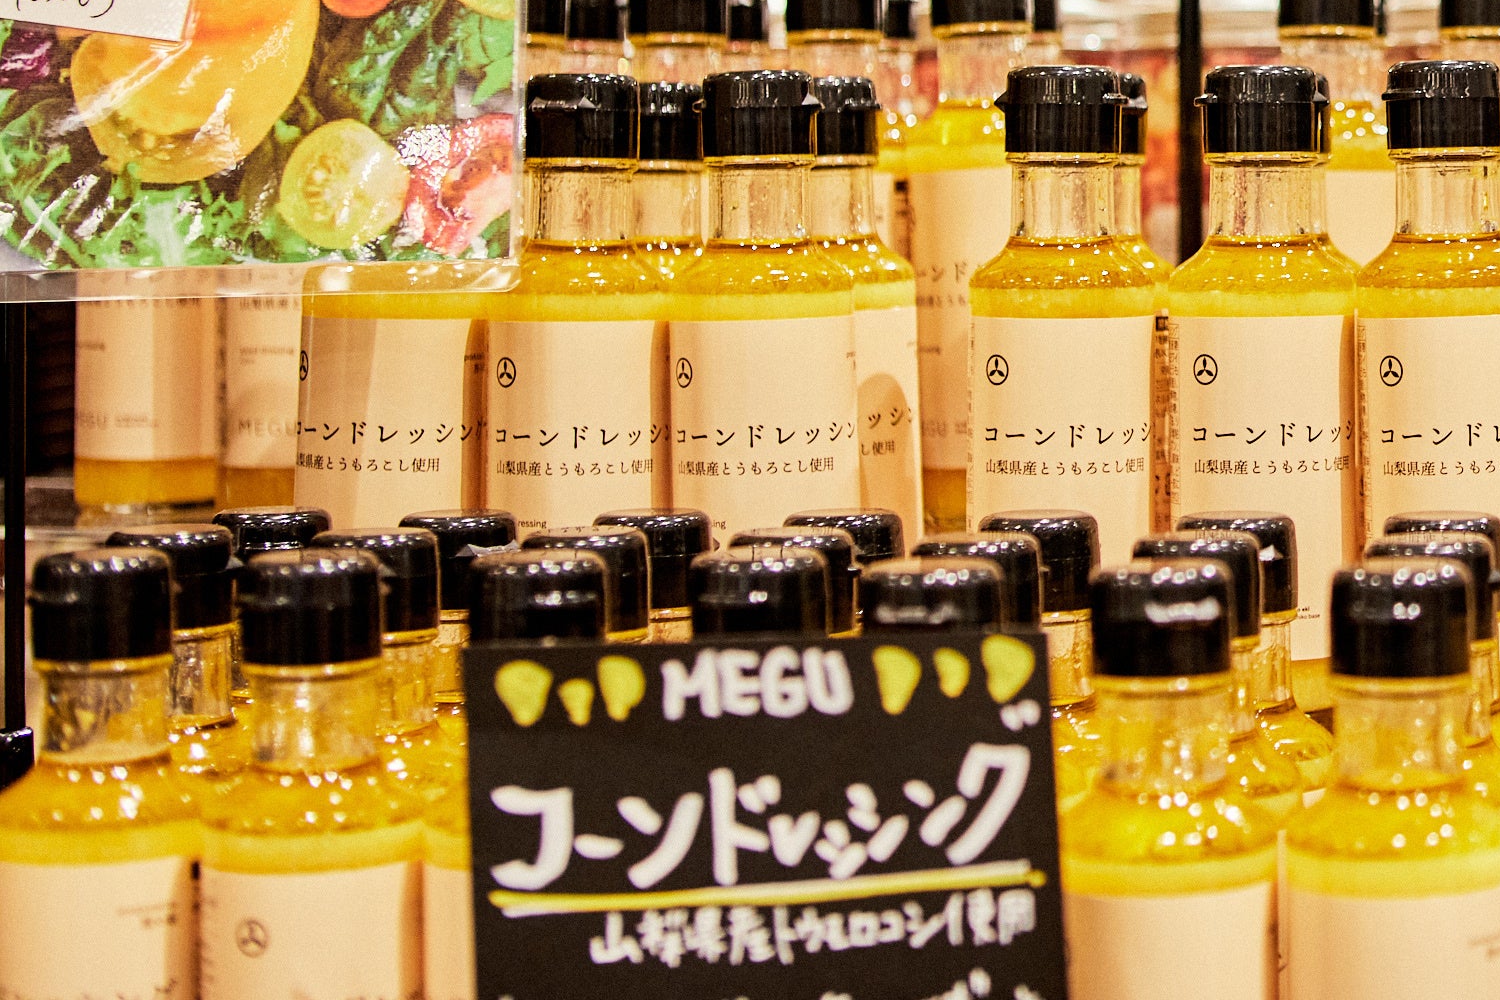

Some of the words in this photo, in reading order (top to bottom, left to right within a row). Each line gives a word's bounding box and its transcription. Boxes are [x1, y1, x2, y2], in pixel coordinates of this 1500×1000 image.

[297, 452, 440, 472] 梨県産とうもろこし使用
[496, 458, 653, 477] 山梨県産とうもろこし使用
[678, 456, 834, 477] 山梨県産とうもろこし使用
[985, 457, 1144, 477] 山梨県産とうもろこし使用
[1194, 456, 1350, 475] 山梨県産とうもろこし使用
[517, 519, 547, 530] ressing
[661, 645, 854, 720] MEGU
[490, 700, 1042, 890] コーンドレッシング
